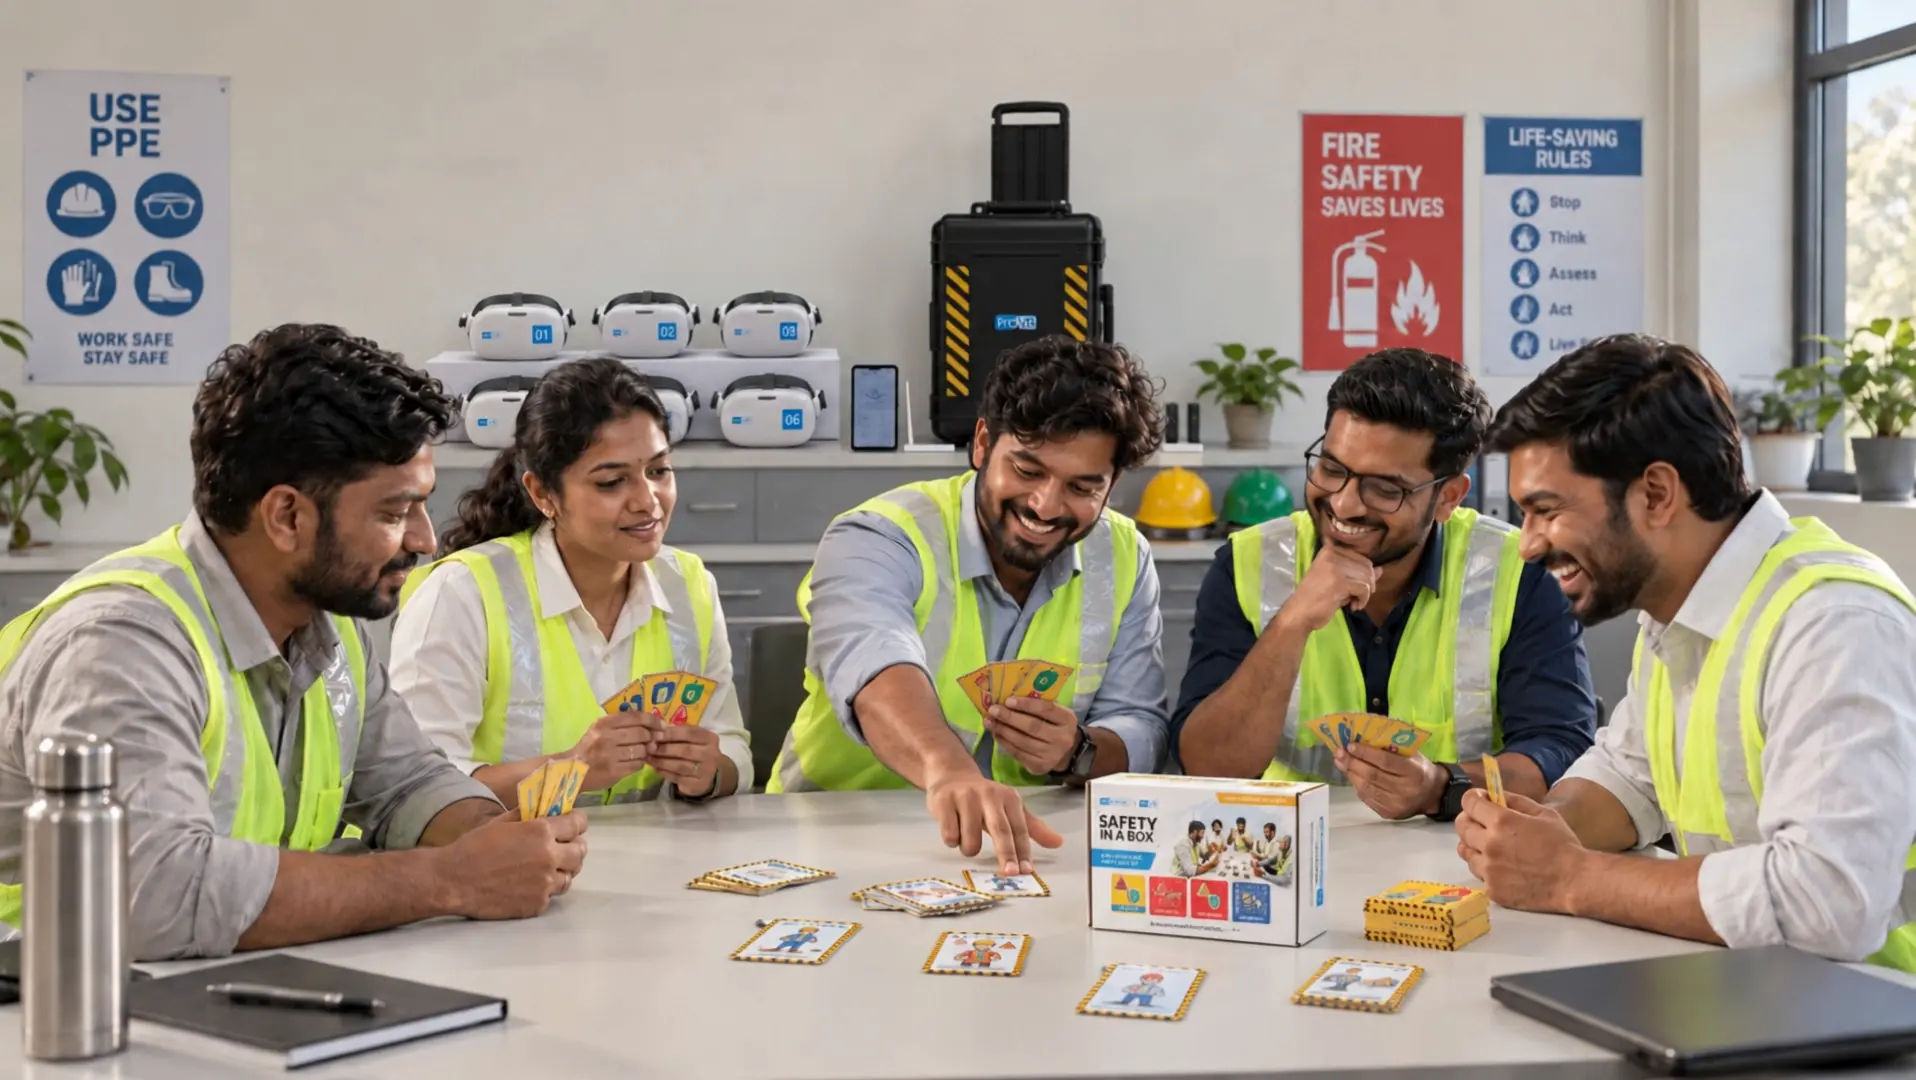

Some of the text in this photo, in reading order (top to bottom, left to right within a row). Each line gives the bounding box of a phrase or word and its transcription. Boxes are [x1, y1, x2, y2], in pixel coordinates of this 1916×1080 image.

[89, 92, 161, 123] USE
[90, 127, 161, 158] PPE
[1508, 127, 1618, 148] LIFE-SAVING
[1321, 132, 1381, 159] FIRE
[1535, 150, 1592, 169] RULES
[1321, 165, 1423, 191] SAFETY
[1320, 196, 1444, 218] SAVES LIVES
[1550, 196, 1581, 211] Stop
[1549, 231, 1587, 245] Think
[1549, 267, 1597, 281] Assess
[1549, 303, 1573, 317] Act
[534, 328, 549, 341] 01
[660, 326, 676, 338] 02
[781, 326, 796, 337] 03
[77, 332, 174, 347] WORK SAFE
[83, 350, 169, 365] STAY SAFE
[785, 414, 800, 426] 06
[1099, 814, 1158, 831] SAFETY
[1100, 829, 1154, 843] IN A BOX
